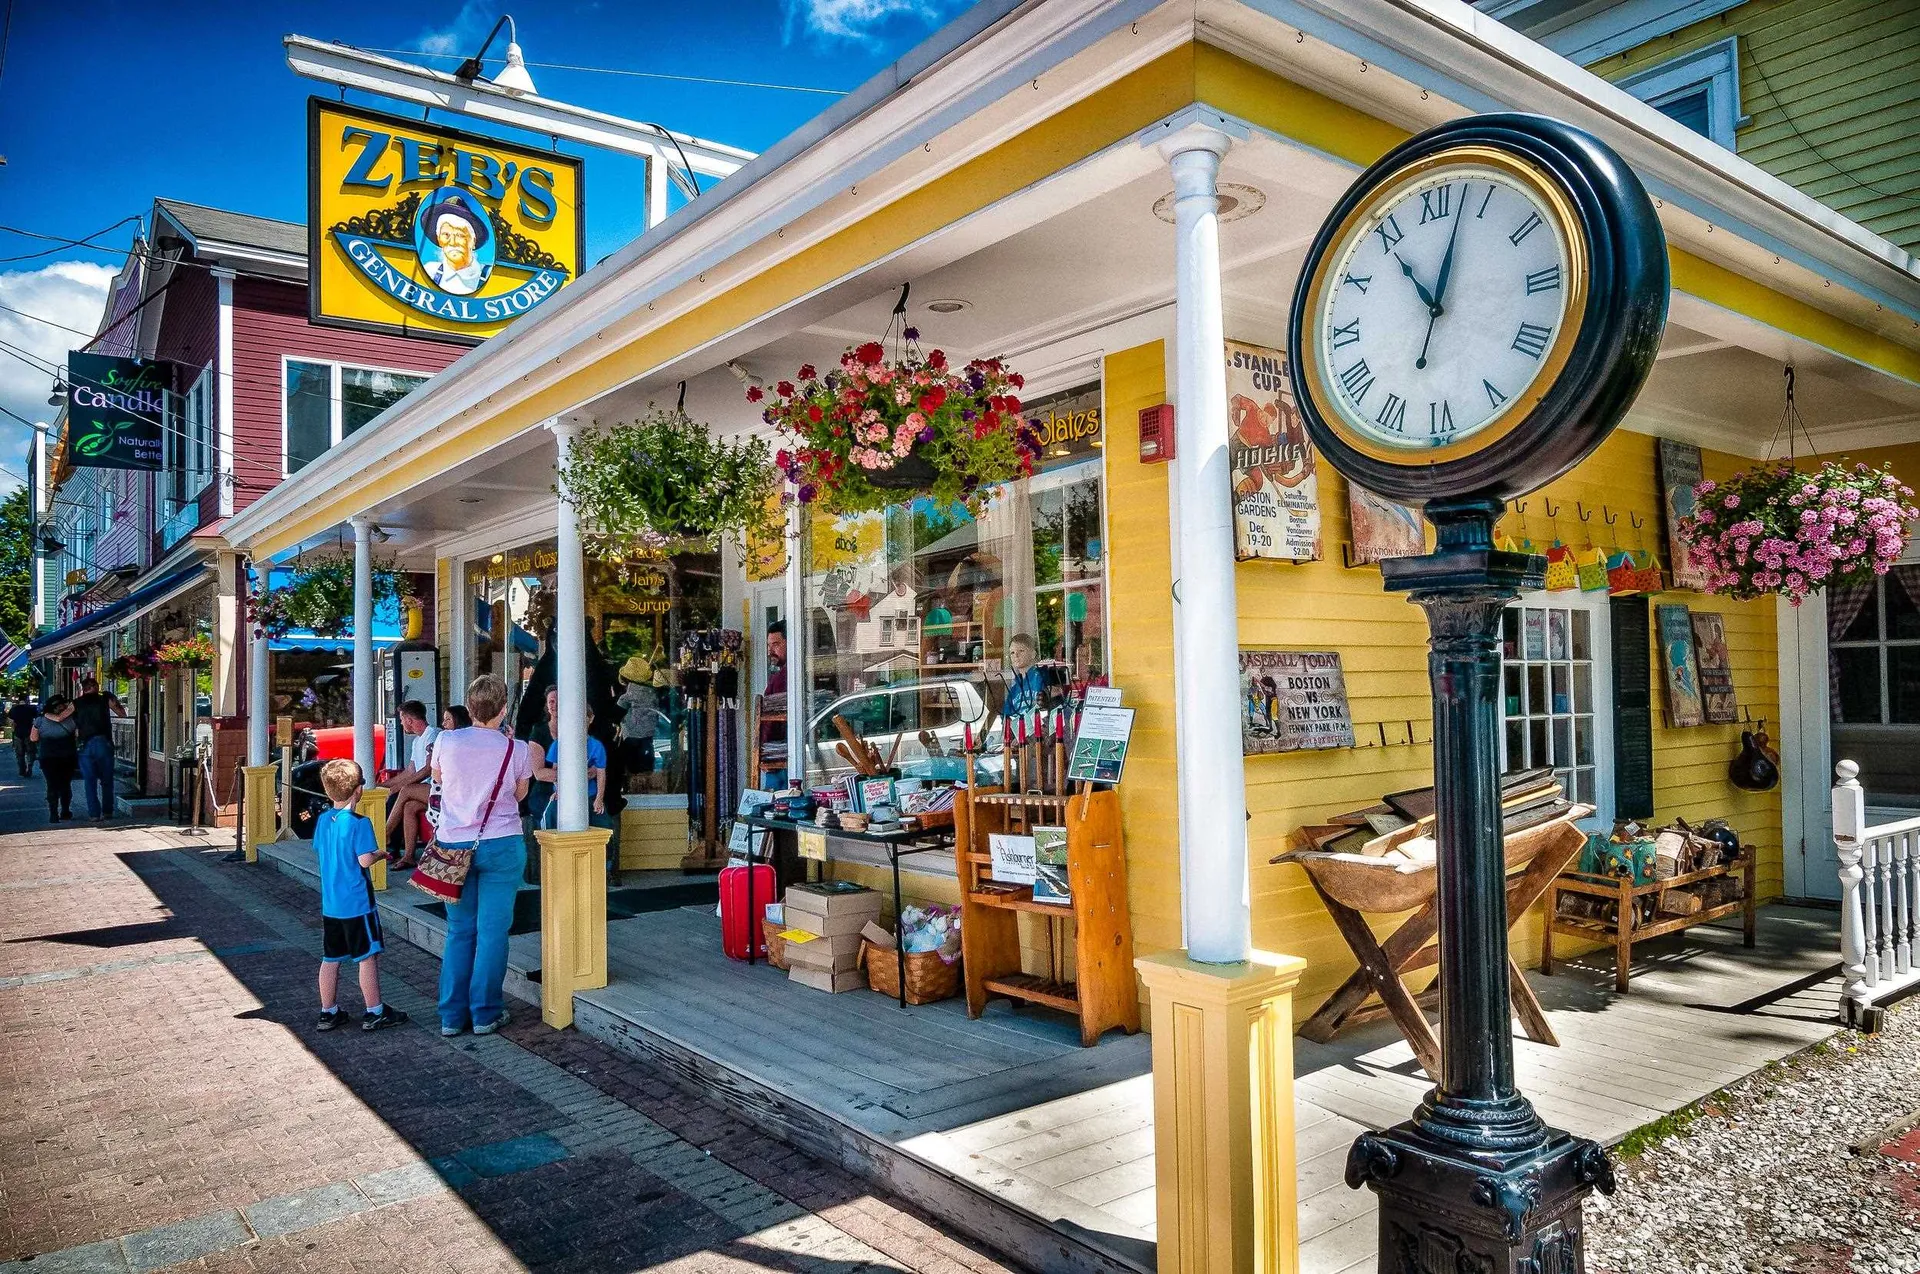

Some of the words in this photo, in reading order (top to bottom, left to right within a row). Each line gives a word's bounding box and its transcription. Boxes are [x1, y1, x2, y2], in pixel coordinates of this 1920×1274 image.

[341, 125, 558, 223] ZEB'S
[1419, 184, 1452, 225] XII
[1476, 185, 1496, 219] I
[1374, 213, 1404, 254] XI
[1508, 211, 1543, 247] II
[347, 239, 478, 320] GENERAL
[485, 271, 558, 320] STORE
[1343, 271, 1372, 294] X
[1526, 264, 1560, 296] III
[1333, 317, 1360, 350] IX
[1510, 321, 1553, 361] IIII
[1233, 351, 1290, 377] STANLE
[1252, 372, 1282, 392] CUP
[1340, 358, 1376, 406] VIII
[1482, 378, 1508, 409] V
[1375, 393, 1407, 433] VII
[1429, 400, 1456, 434] VI
[134, 449, 163, 460] Bette
[1235, 442, 1315, 469] HOCKEY
[1240, 491, 1271, 504] BOSTON
[1277, 500, 1317, 510] ELIMINATIONS
[1237, 503, 1276, 518] GARDENS
[1289, 516, 1307, 524] Boston
[1249, 521, 1267, 533] Dec.
[1246, 534, 1272, 547] 19-20
[1285, 538, 1315, 548] Admission
[1293, 547, 1310, 556] $2.00
[632, 572, 666, 588] Jams
[628, 597, 671, 615] Syrup
[1300, 654, 1338, 672] TODAY
[1288, 677, 1331, 689] BOSTON
[1287, 707, 1310, 720] NEW
[1313, 705, 1343, 719] YORK
[1288, 724, 1313, 734] FENWAY
[1315, 724, 1331, 733] PARK
